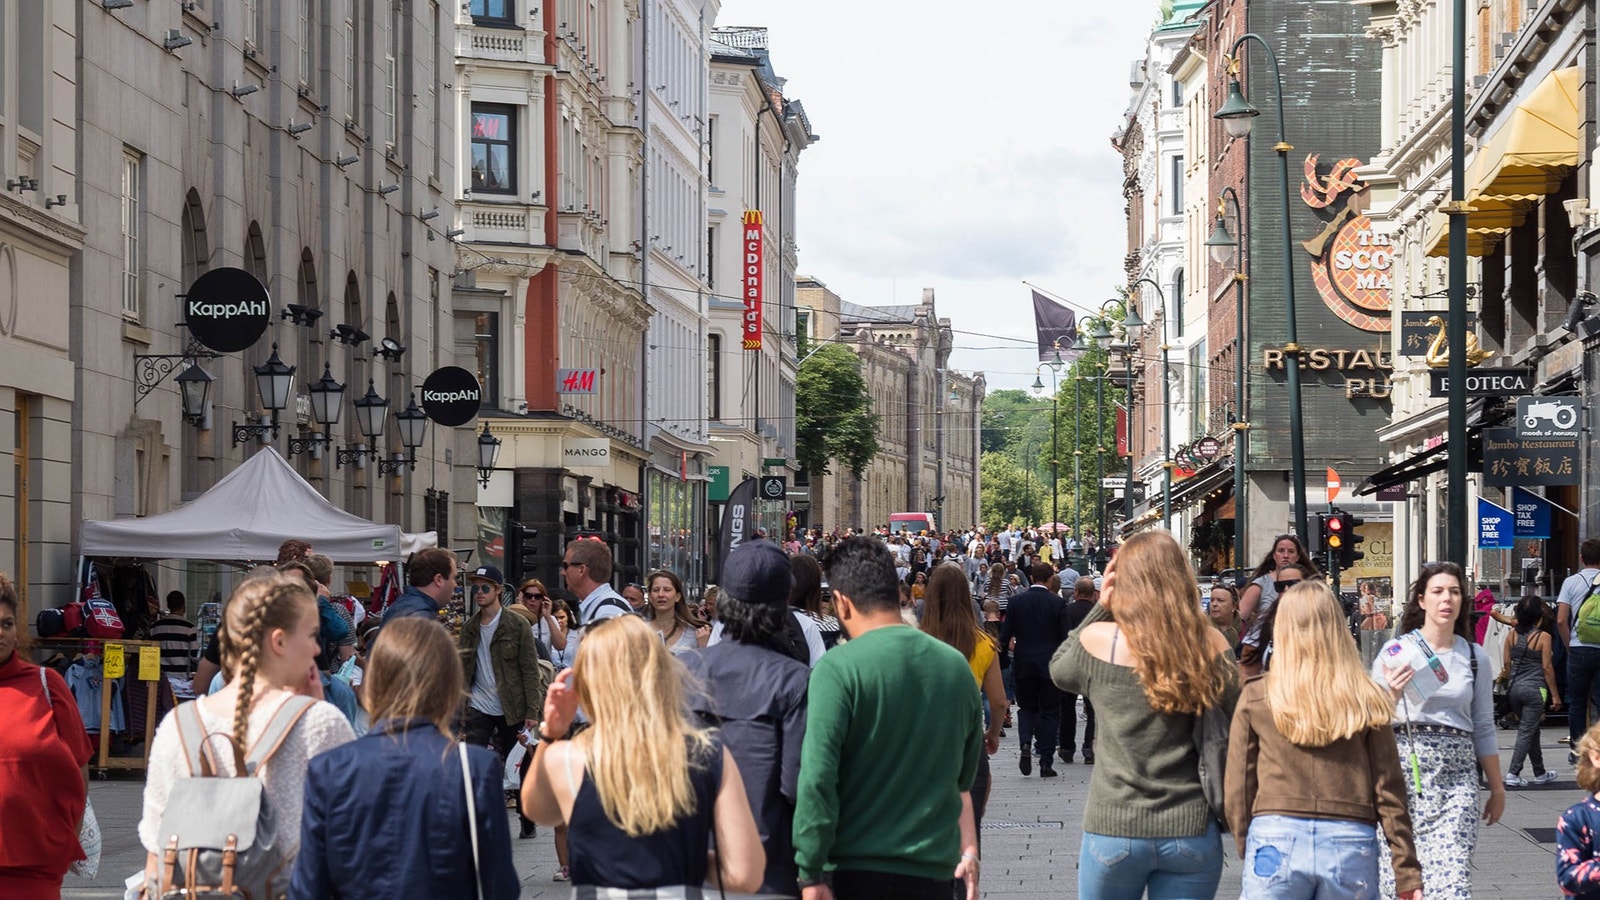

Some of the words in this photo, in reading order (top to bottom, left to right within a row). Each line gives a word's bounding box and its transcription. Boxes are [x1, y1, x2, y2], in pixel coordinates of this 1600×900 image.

[746, 229, 759, 332] McDonald's
[189, 301, 266, 319] KappAhl
[563, 371, 595, 392] H&M
[1441, 376, 1526, 391] EOTECA
[424, 389, 479, 403] KappAhl
[1487, 439, 1519, 450] Jambo
[1521, 440, 1576, 449] Restaurant
[564, 448, 608, 457] MANGO
[730, 504, 745, 553] NGS
[1481, 531, 1499, 539] FREE
